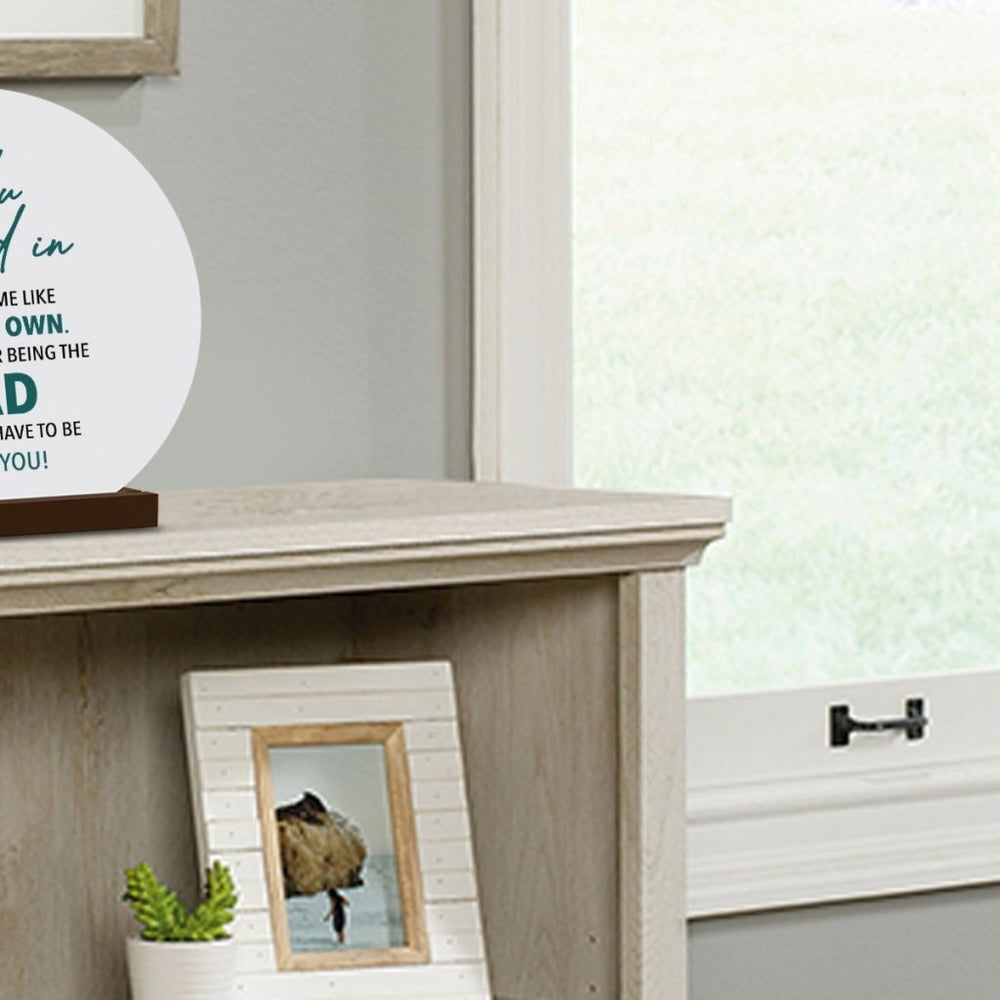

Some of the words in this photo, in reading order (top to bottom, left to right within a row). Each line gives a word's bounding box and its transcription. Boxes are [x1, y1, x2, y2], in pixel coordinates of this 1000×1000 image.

[32, 237, 74, 257] in
[23, 288, 56, 305] LIKE
[5, 313, 69, 337] OWN.
[7, 345, 56, 362] BEING
[59, 342, 89, 359] THE
[36, 422, 57, 438] TO
[62, 421, 82, 436] BE
[0, 451, 48, 471] YOU!
